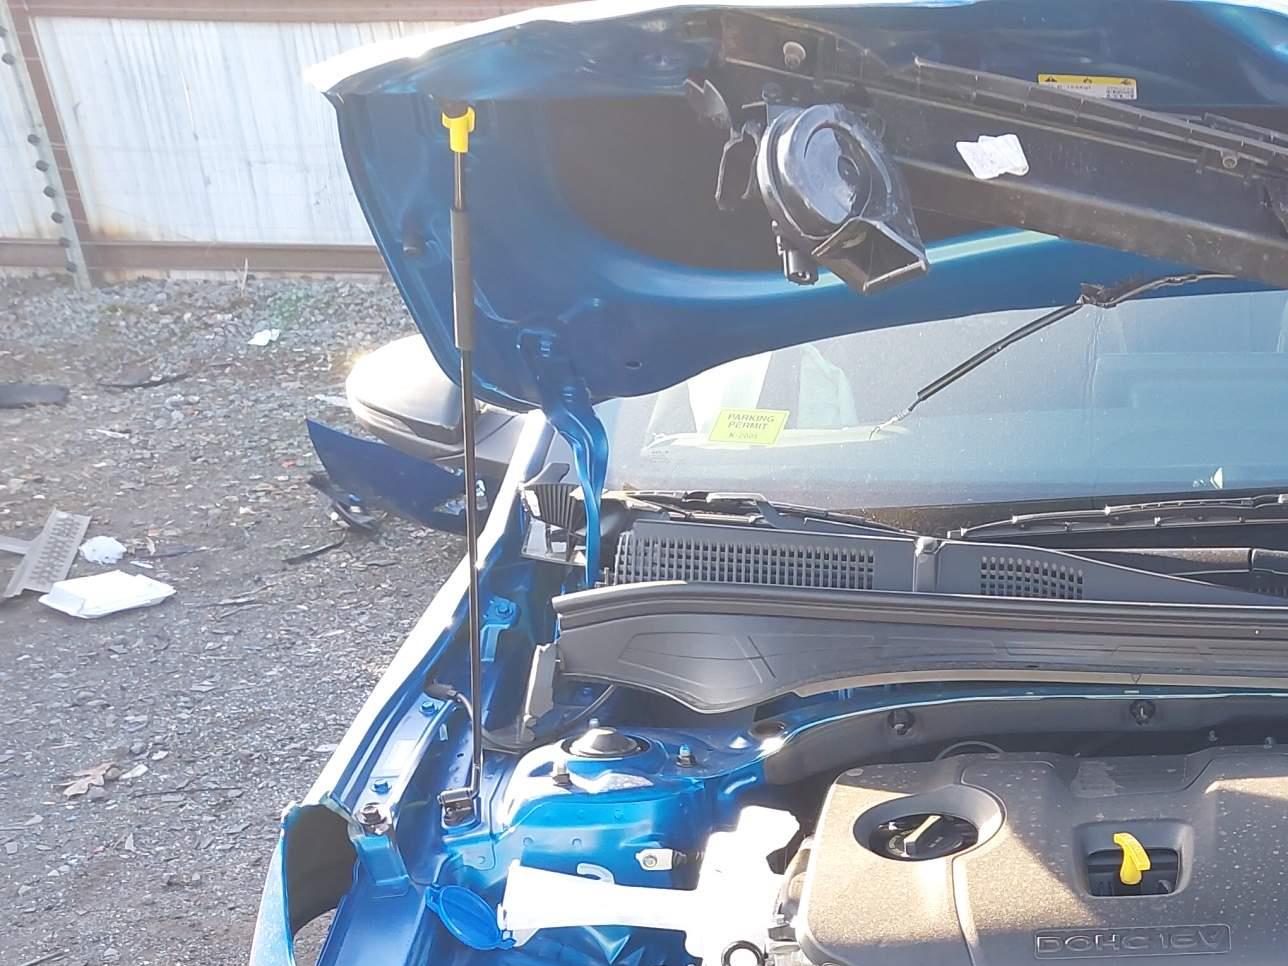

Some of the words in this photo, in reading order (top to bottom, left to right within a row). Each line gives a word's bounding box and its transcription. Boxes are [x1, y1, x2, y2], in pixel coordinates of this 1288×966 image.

[727, 413, 775, 423] PARKING
[727, 421, 769, 430] PERMIT
[1036, 933, 1150, 953] DOHC
